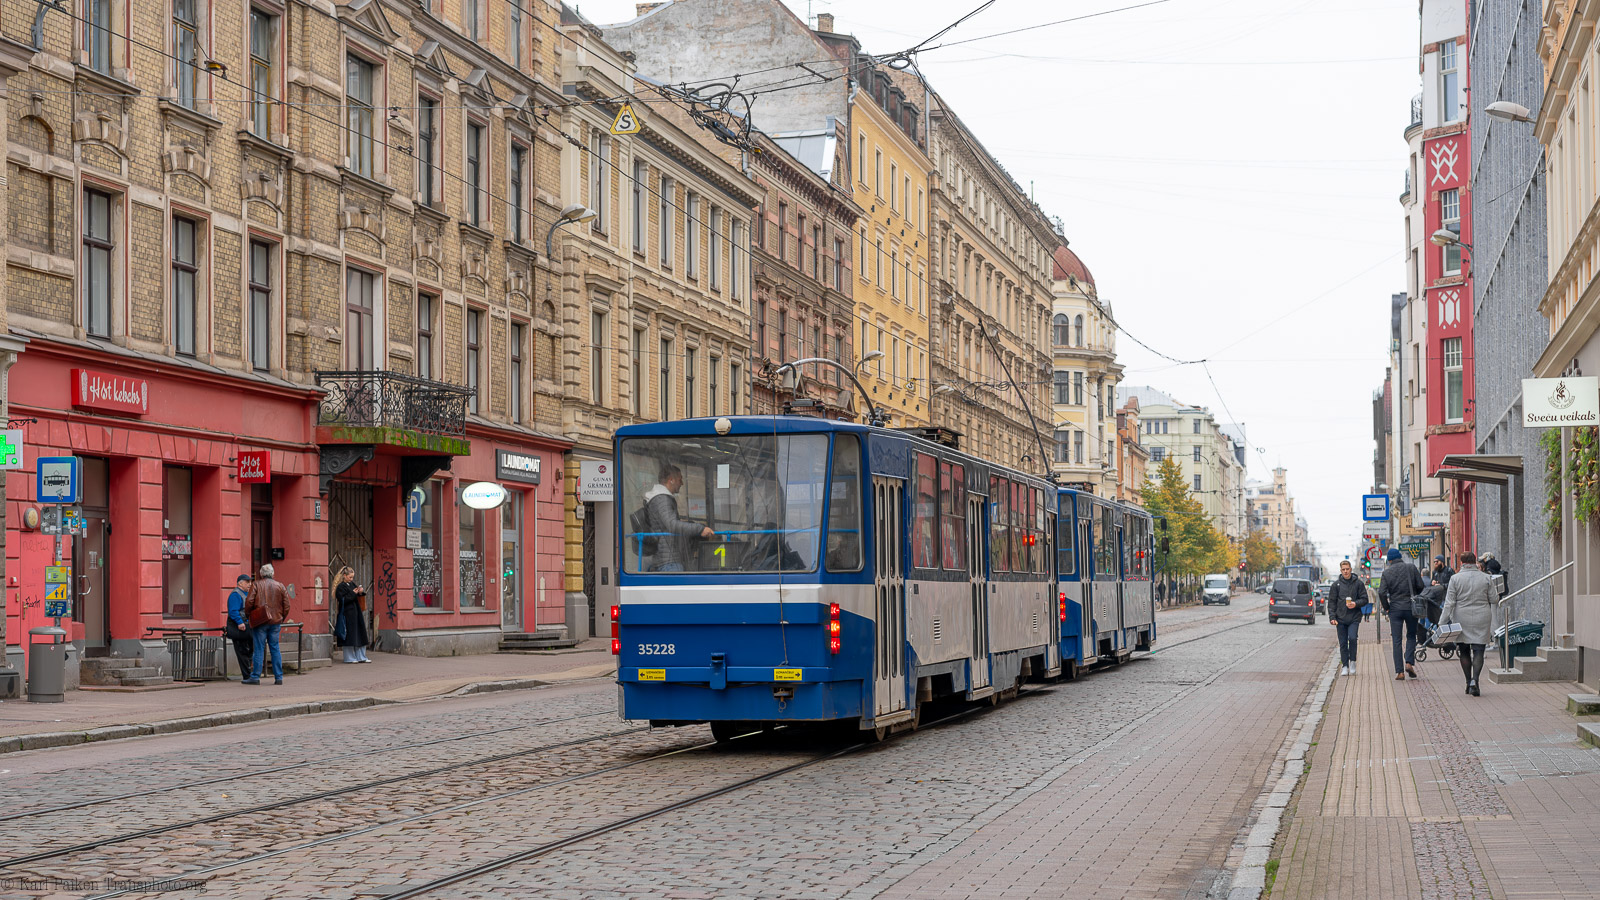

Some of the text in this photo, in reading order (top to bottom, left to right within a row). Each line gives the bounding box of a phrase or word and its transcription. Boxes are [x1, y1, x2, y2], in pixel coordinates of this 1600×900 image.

[620, 115, 631, 129] S
[89, 376, 112, 403] Hot
[1560, 410, 1596, 422] veikals
[241, 456, 260, 469] Hot
[409, 495, 418, 524] P
[714, 544, 726, 567] 1
[638, 644, 676, 655] 35228
